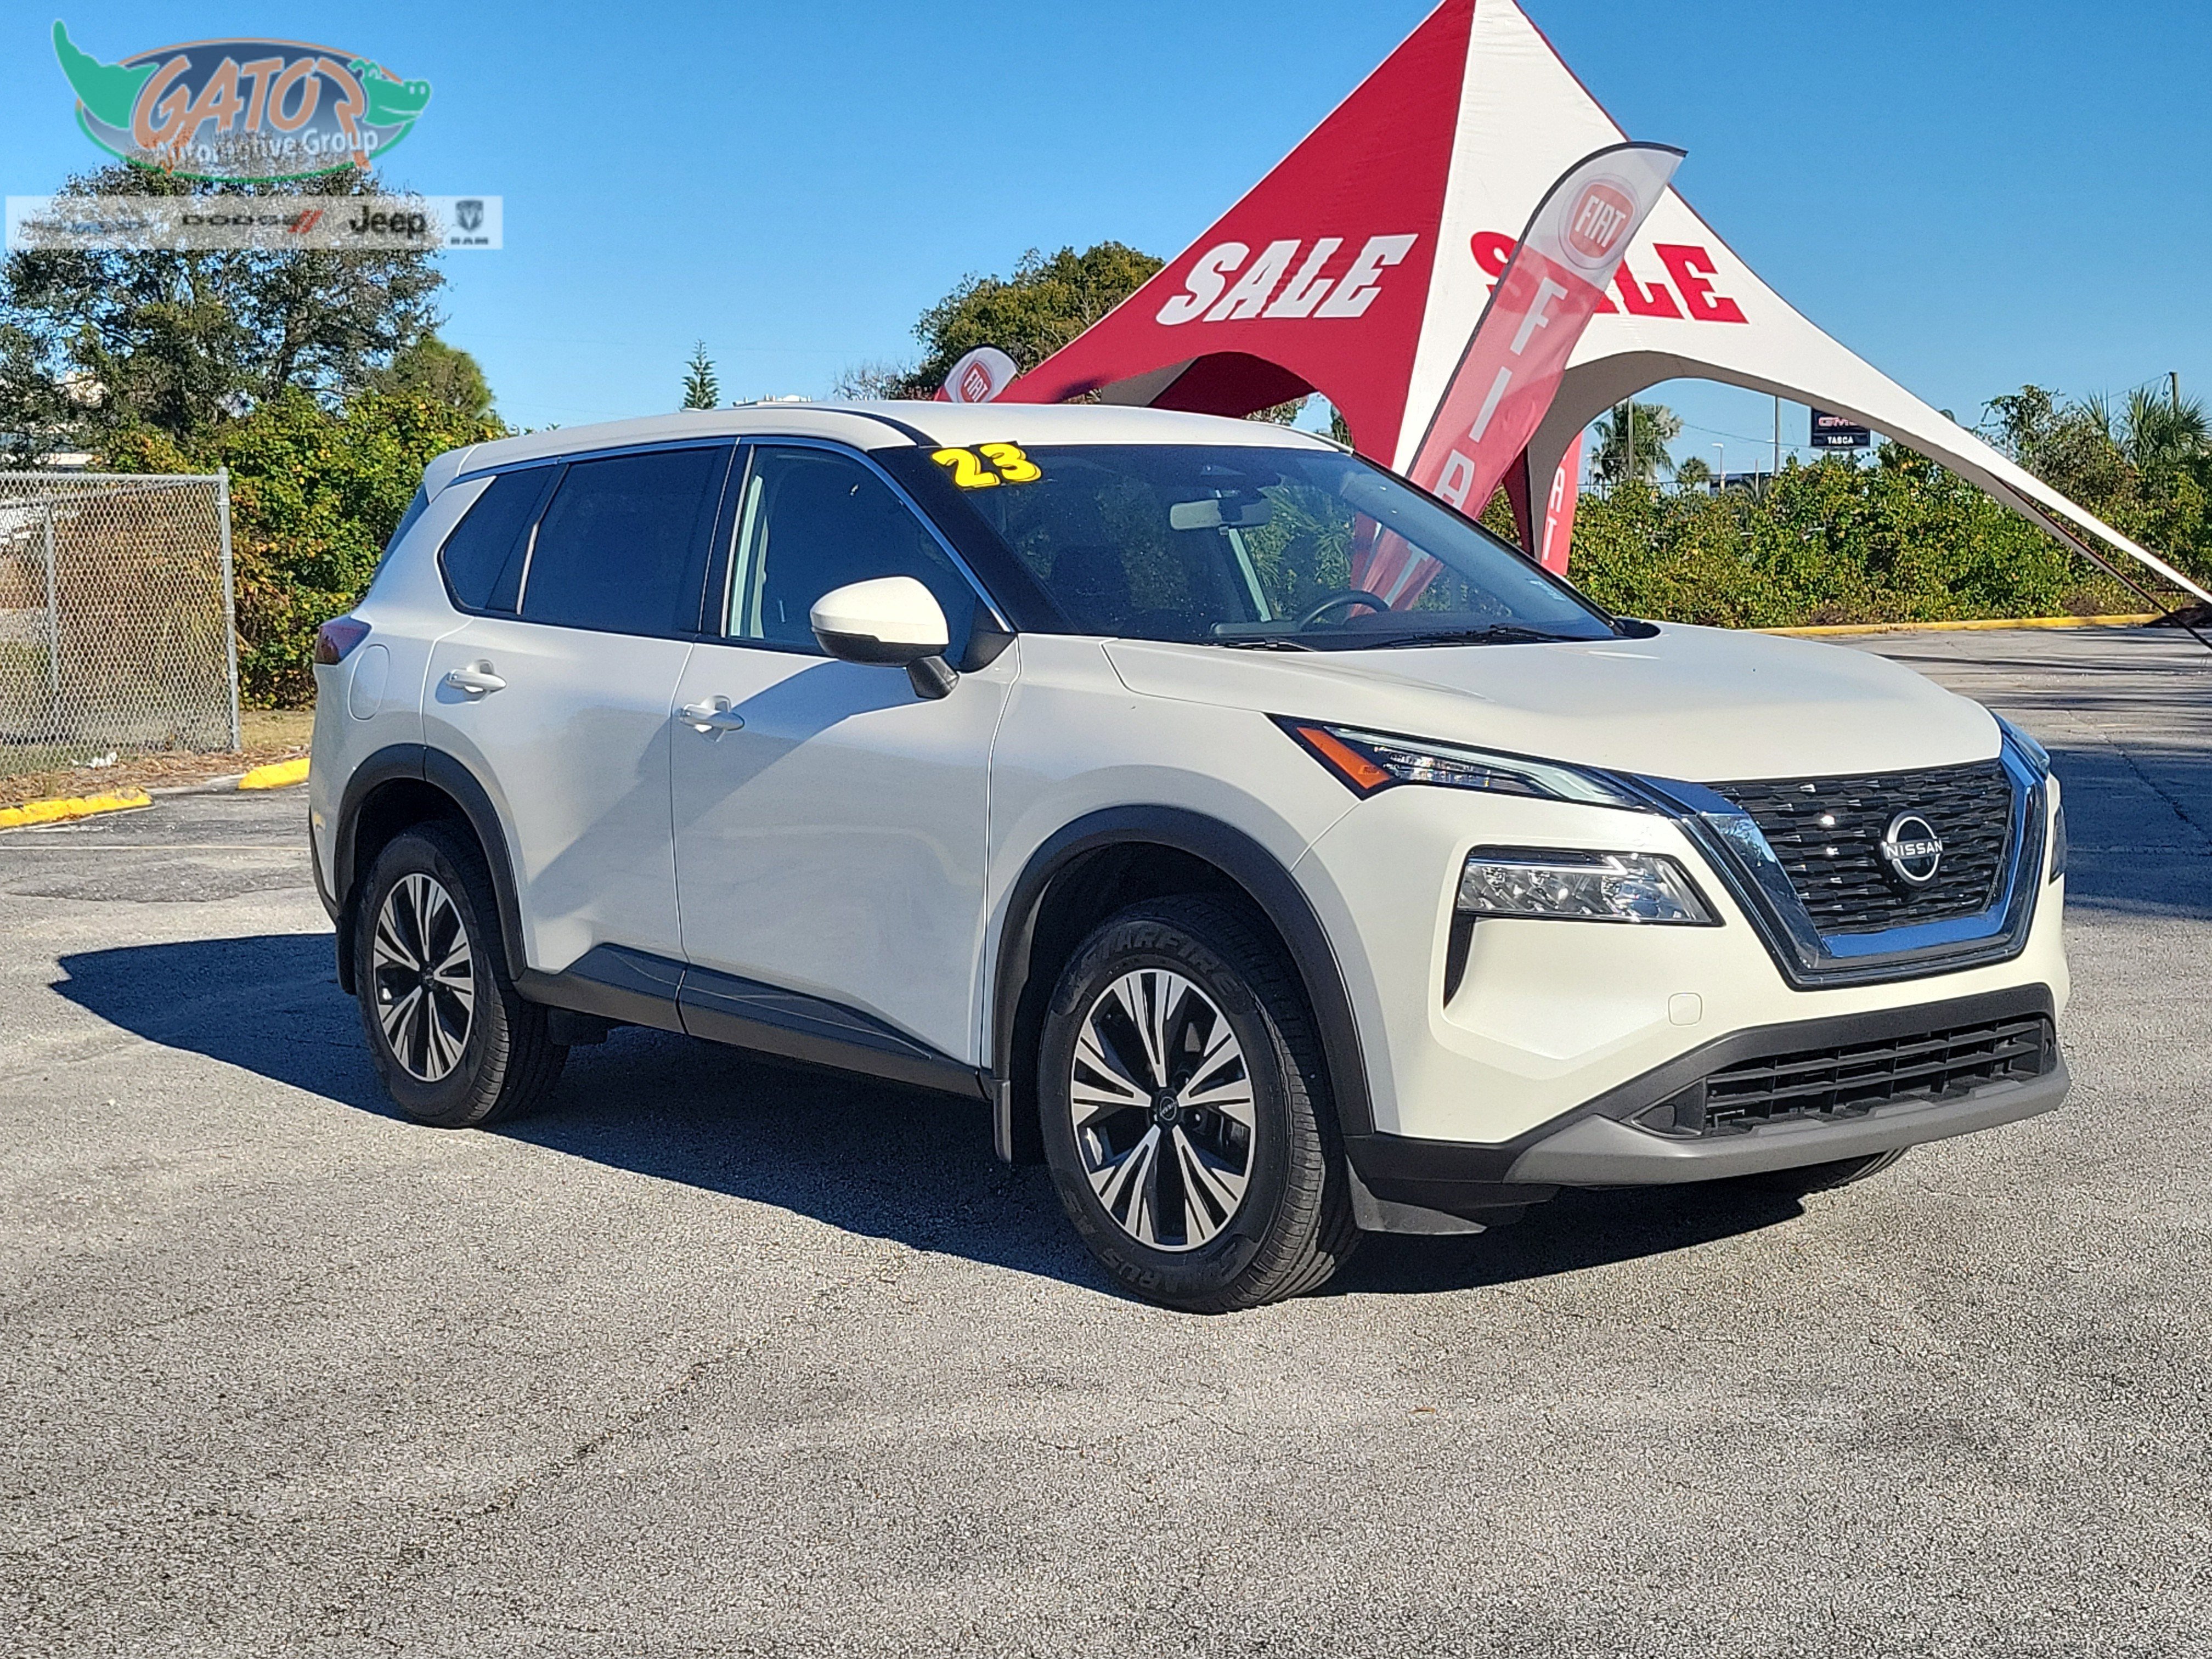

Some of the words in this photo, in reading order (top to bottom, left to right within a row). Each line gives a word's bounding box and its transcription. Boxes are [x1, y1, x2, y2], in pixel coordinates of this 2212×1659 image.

[1575, 195, 1626, 248] FIAT
[1155, 233, 1419, 325] SALE
[963, 368, 988, 403] FIAT
[1827, 436, 1854, 444] TASCA
[932, 443, 1041, 488] 23
[1886, 838, 1943, 857] NISSAN
